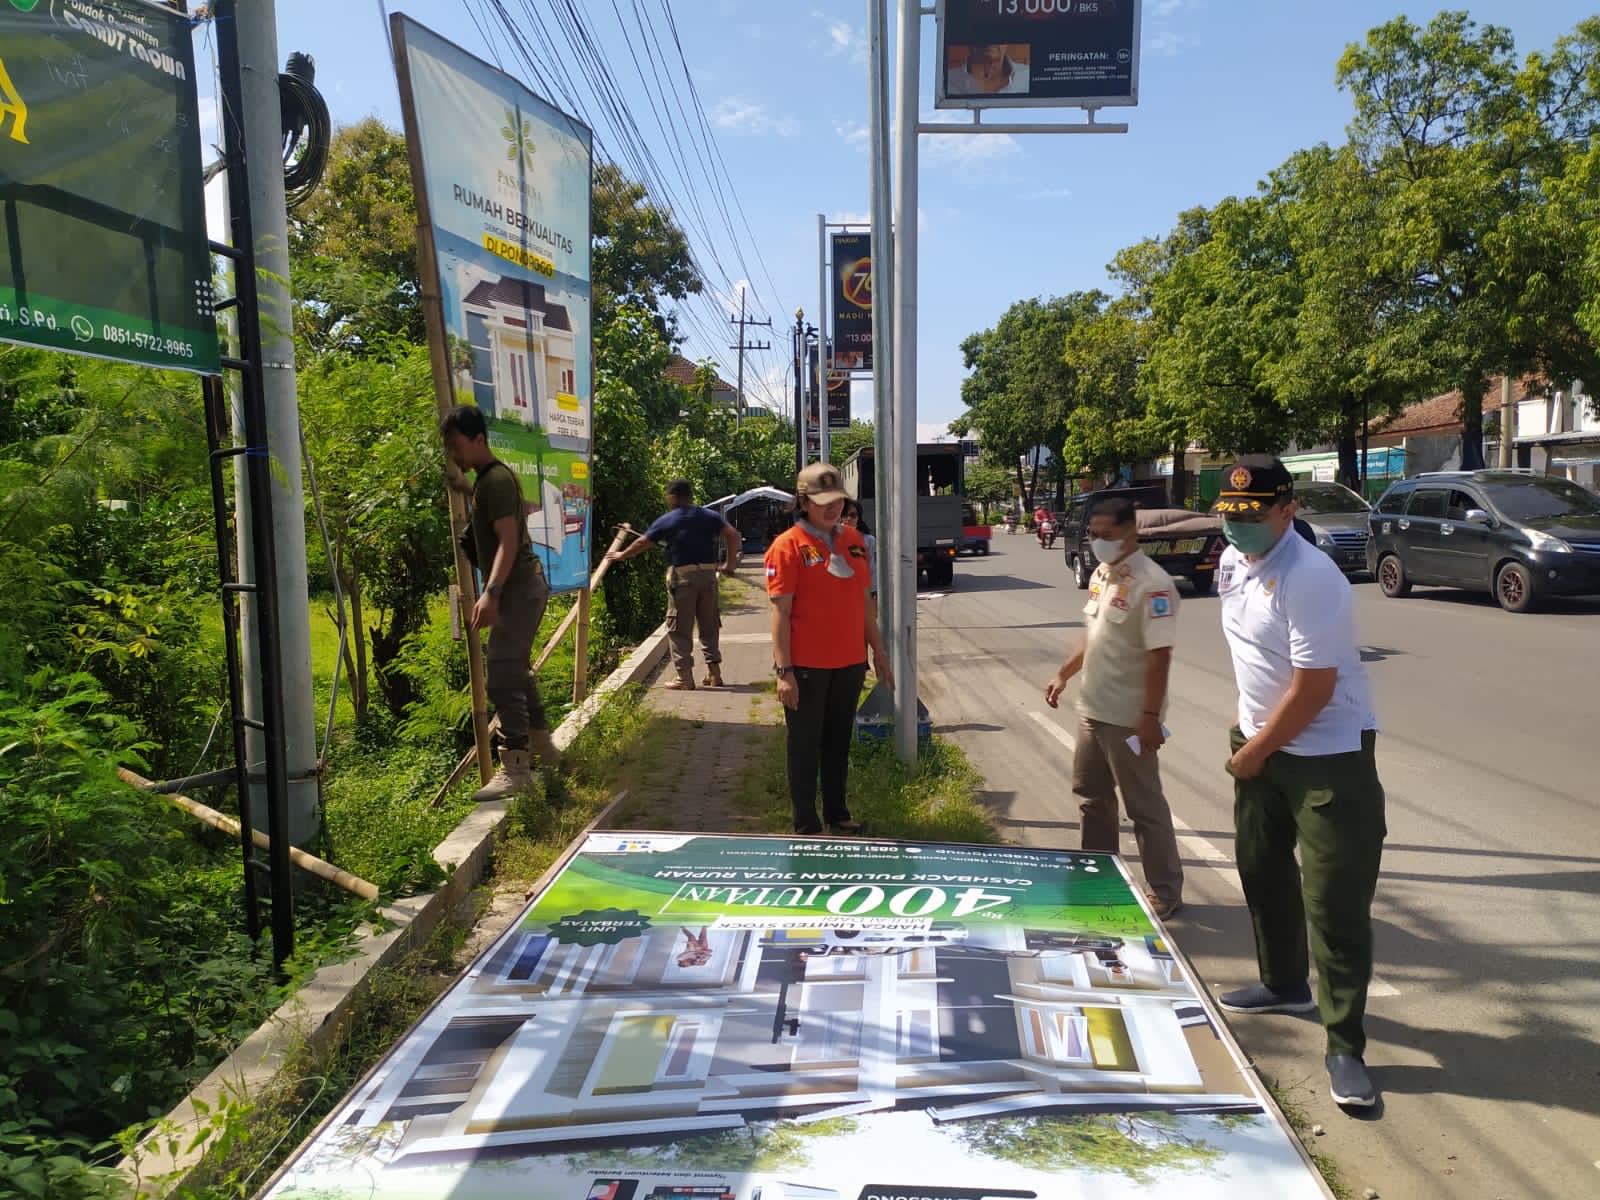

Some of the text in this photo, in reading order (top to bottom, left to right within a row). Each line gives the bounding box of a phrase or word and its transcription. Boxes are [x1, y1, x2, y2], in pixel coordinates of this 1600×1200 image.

[453, 183, 503, 221] RUMAH
[506, 207, 573, 255] BERKUALITAS
[486, 236, 499, 256] DI
[103, 323, 193, 358] 0851-5722-8965
[654, 870, 1033, 886] CASHBACK PULUHAN JUTA RUPIAH
[682, 885, 1012, 917] 400 JUTAAN
